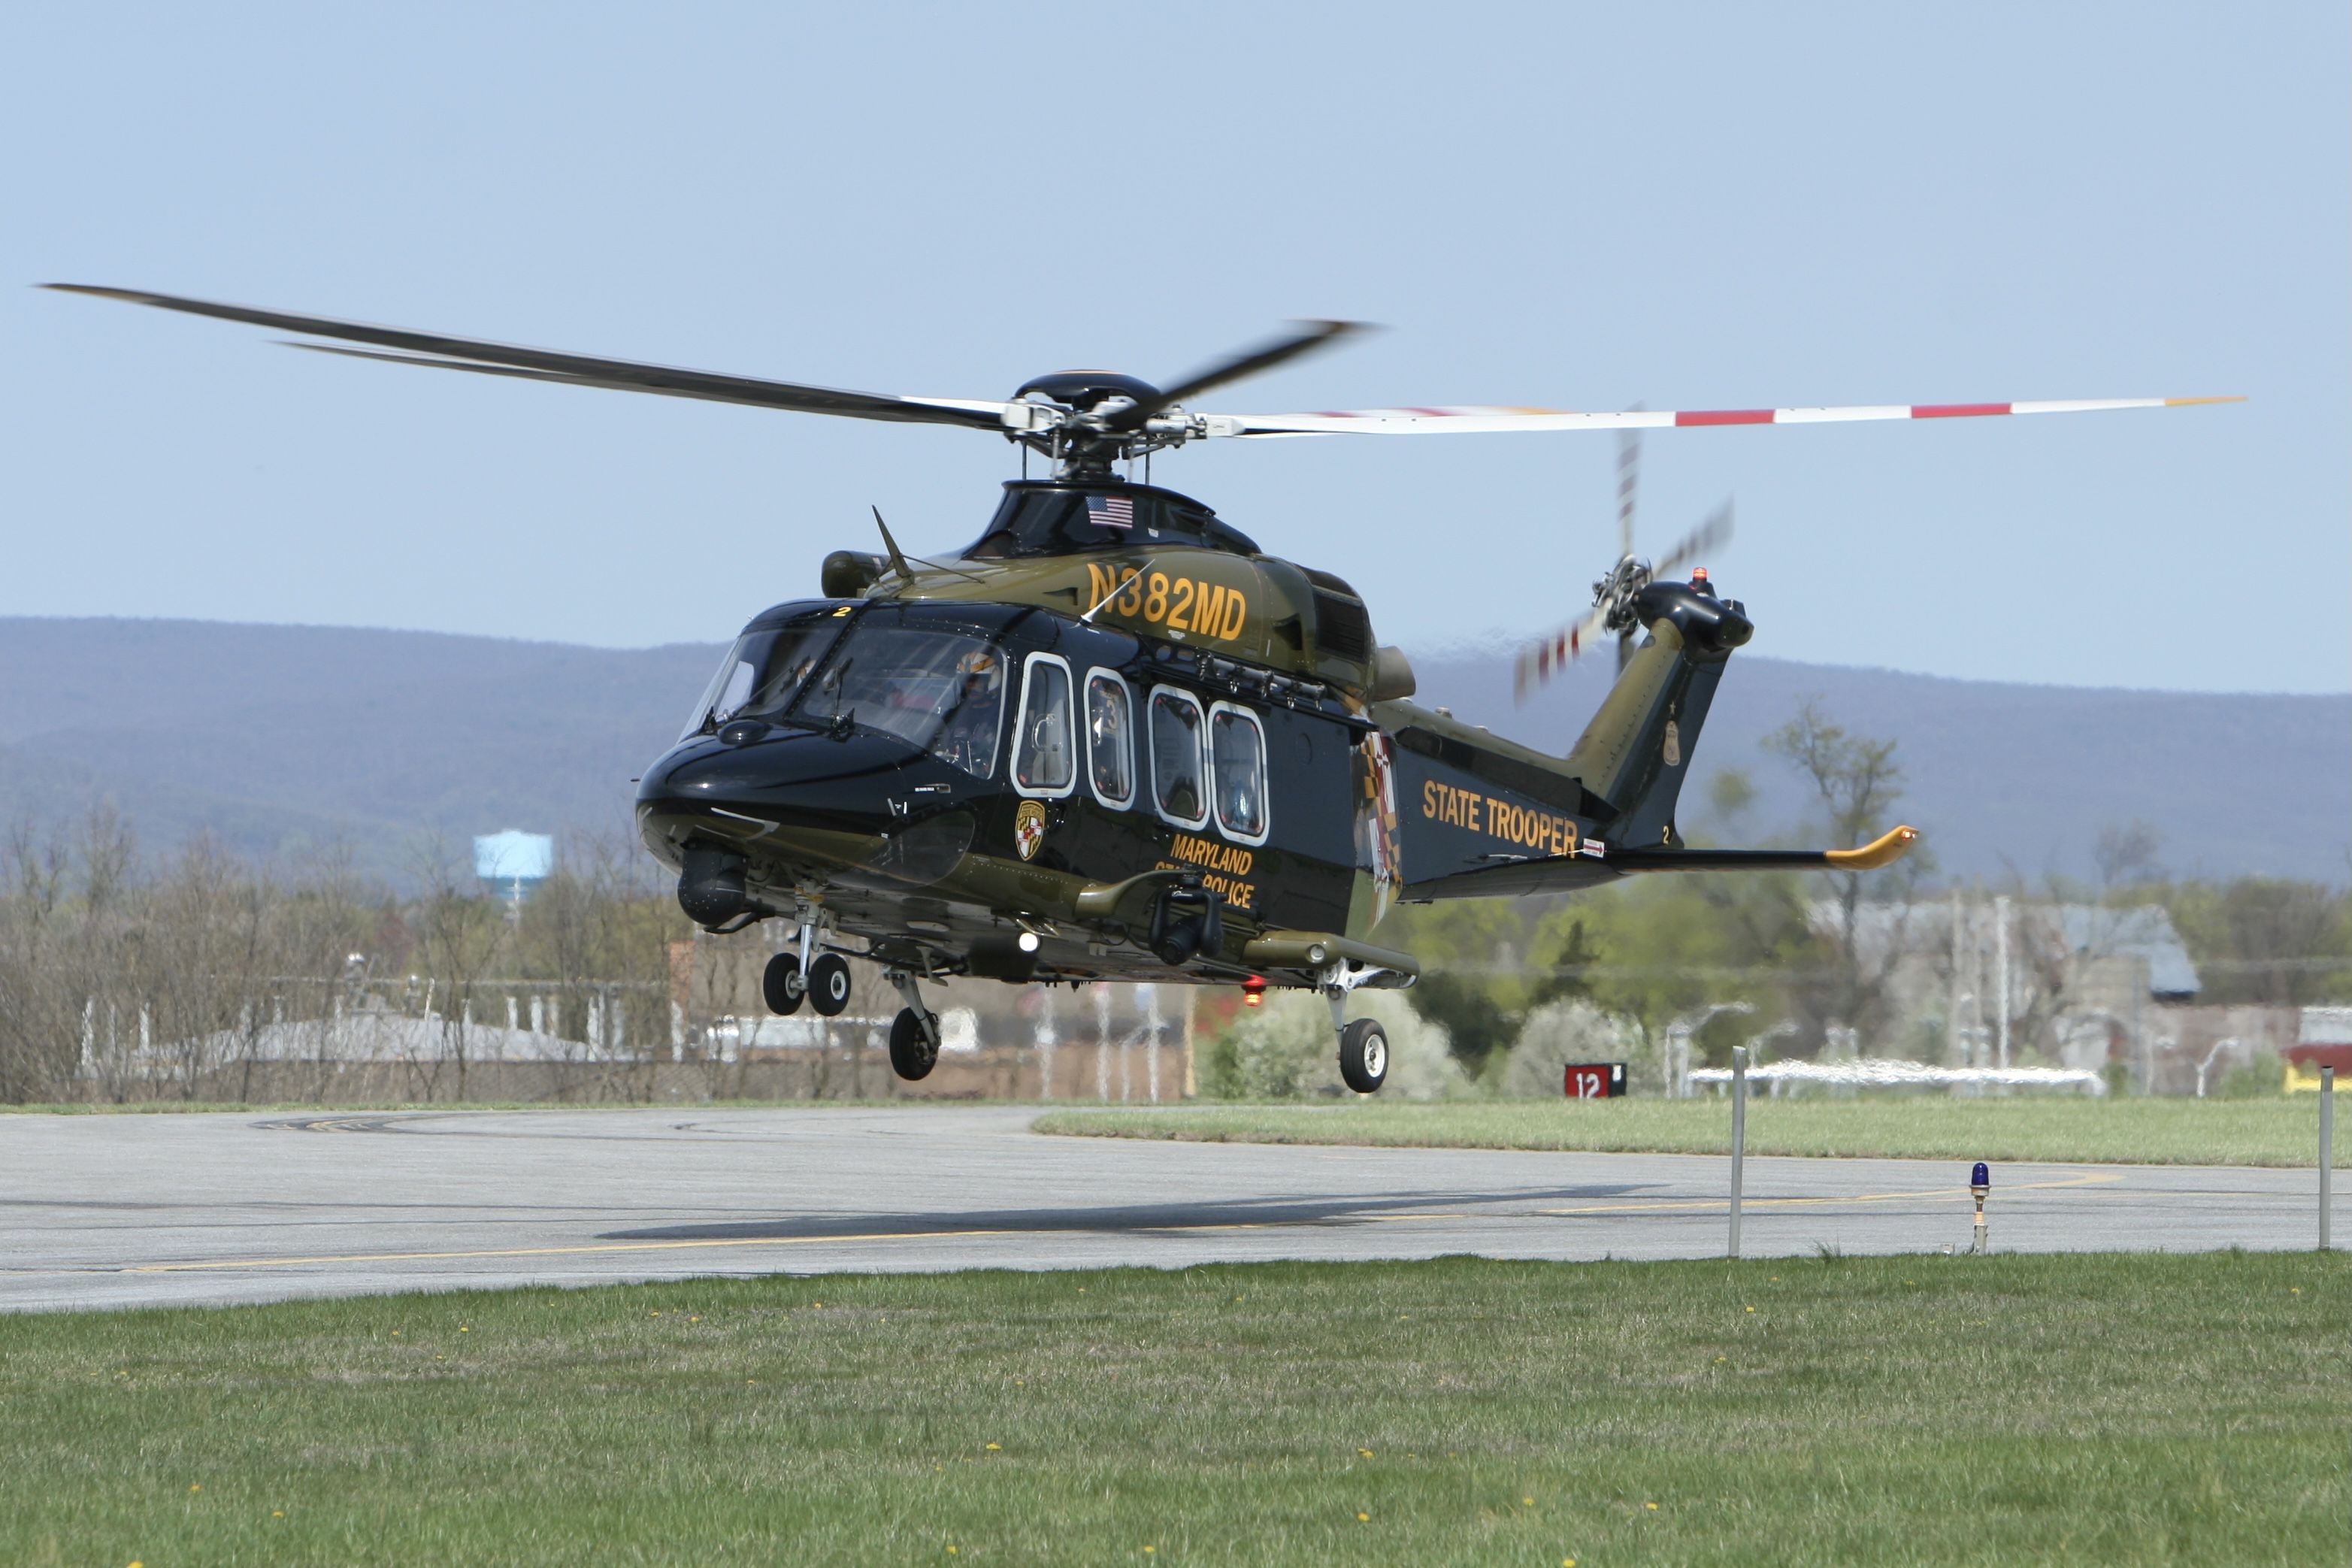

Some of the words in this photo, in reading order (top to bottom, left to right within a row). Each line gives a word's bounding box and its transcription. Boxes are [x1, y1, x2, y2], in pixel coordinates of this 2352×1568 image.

[832, 607, 851, 617] 2
[1087, 563, 1246, 640] N382MD
[1423, 779, 1482, 831] STATE
[1487, 798, 1578, 858] TROOPER
[1663, 825, 1669, 845] 2
[1170, 834, 1253, 876] MARYLAND
[1576, 1073, 1600, 1099] 12
